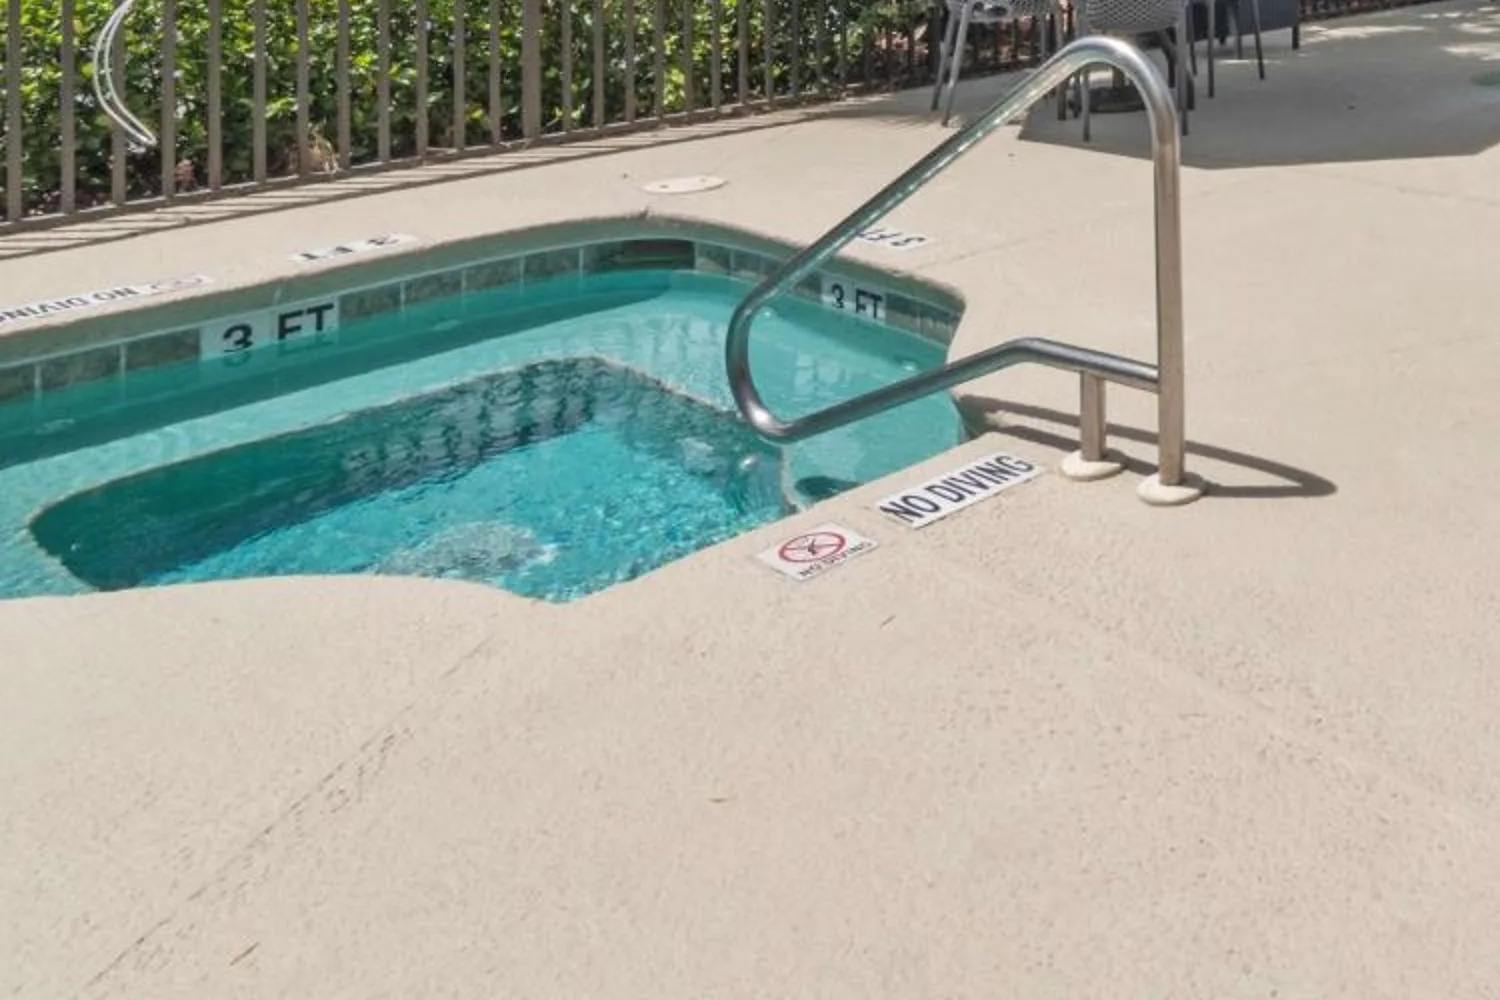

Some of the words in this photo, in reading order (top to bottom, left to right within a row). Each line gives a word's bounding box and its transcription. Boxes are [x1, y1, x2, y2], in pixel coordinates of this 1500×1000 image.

[0, 297, 90, 321] DIVIN
[93, 287, 139, 301] NO
[829, 283, 844, 309] 3
[855, 287, 882, 319] FT
[223, 323, 253, 353] 3
[278, 302, 335, 340] FT
[879, 494, 941, 524] NO
[924, 455, 1034, 503] DIVING
